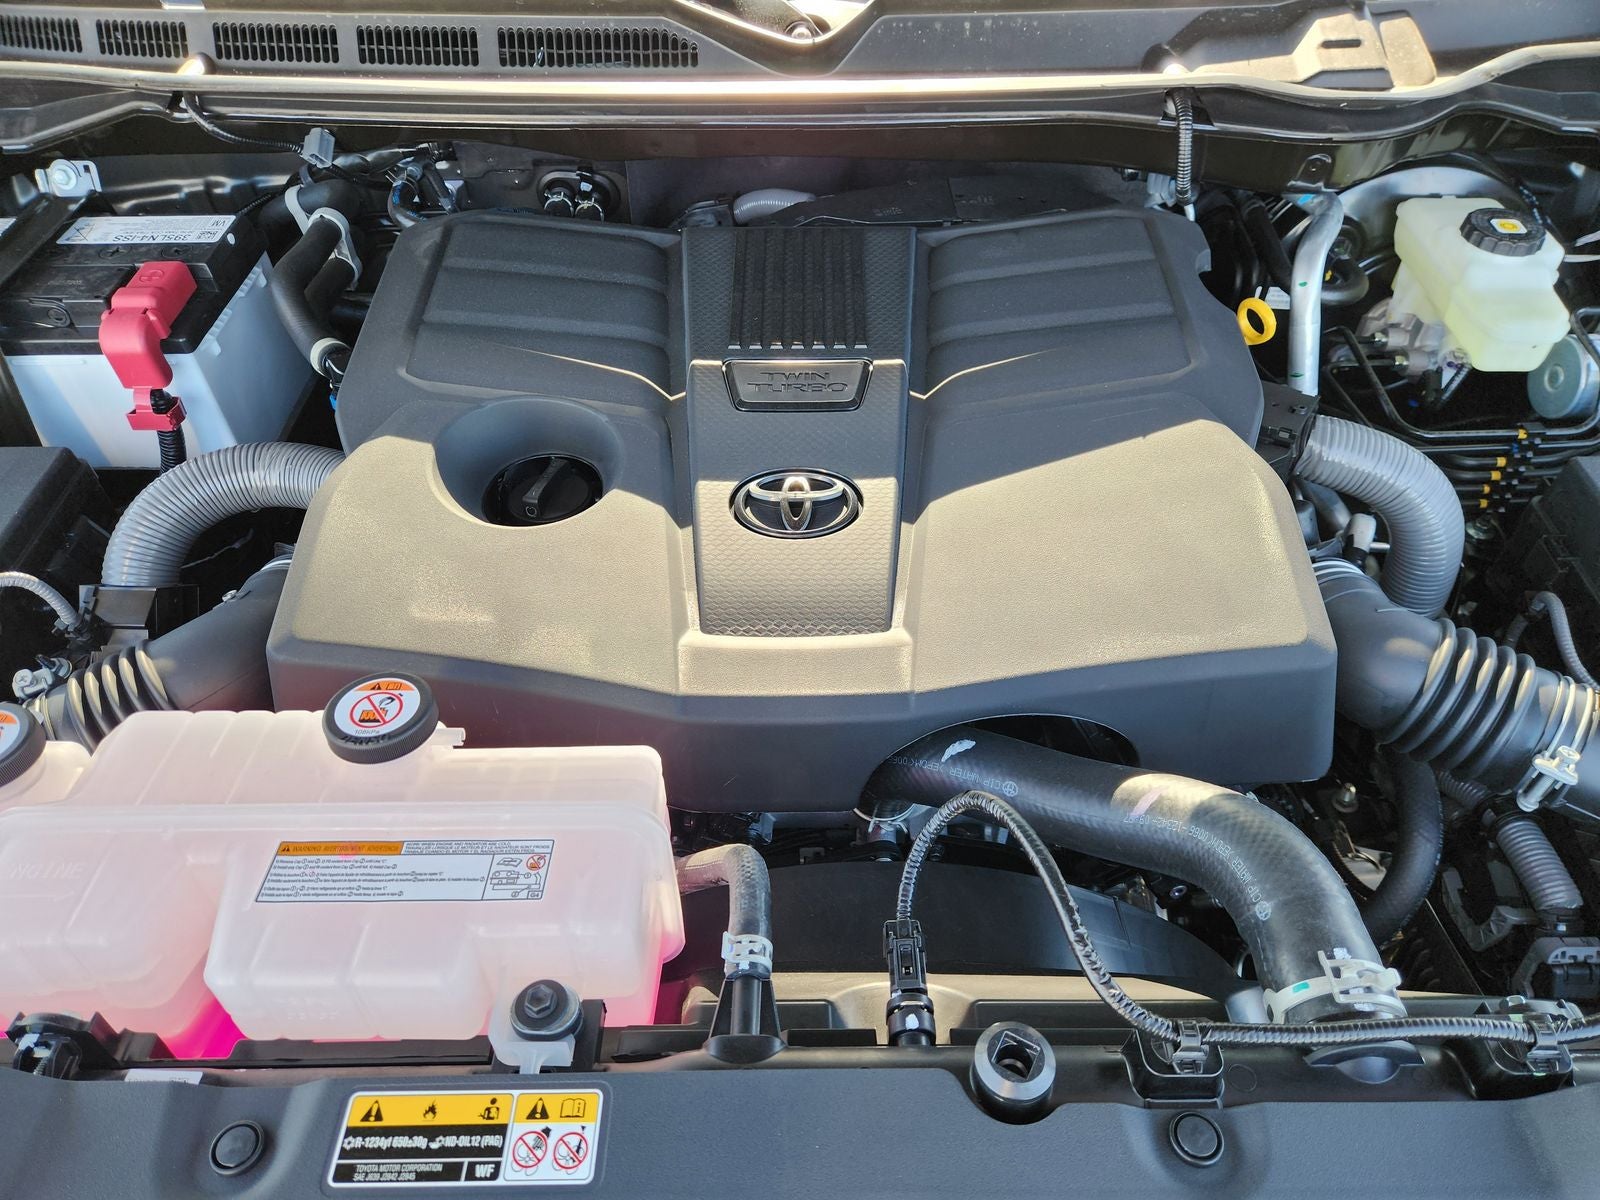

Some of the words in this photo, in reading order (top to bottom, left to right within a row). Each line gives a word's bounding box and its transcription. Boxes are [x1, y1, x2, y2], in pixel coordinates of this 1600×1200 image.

[760, 372, 830, 381] TWIN
[747, 382, 848, 392] TURBO
[949, 766, 981, 783] WATER
[355, 1136, 392, 1150] R-1234yf
[480, 1135, 503, 1148] (PAG)
[356, 1164, 378, 1172] TOYOTA
[379, 1164, 401, 1172] MOTOR
[401, 1163, 443, 1172] CORPORATION
[475, 1163, 495, 1178] WF
[353, 1172, 365, 1181] SAE
